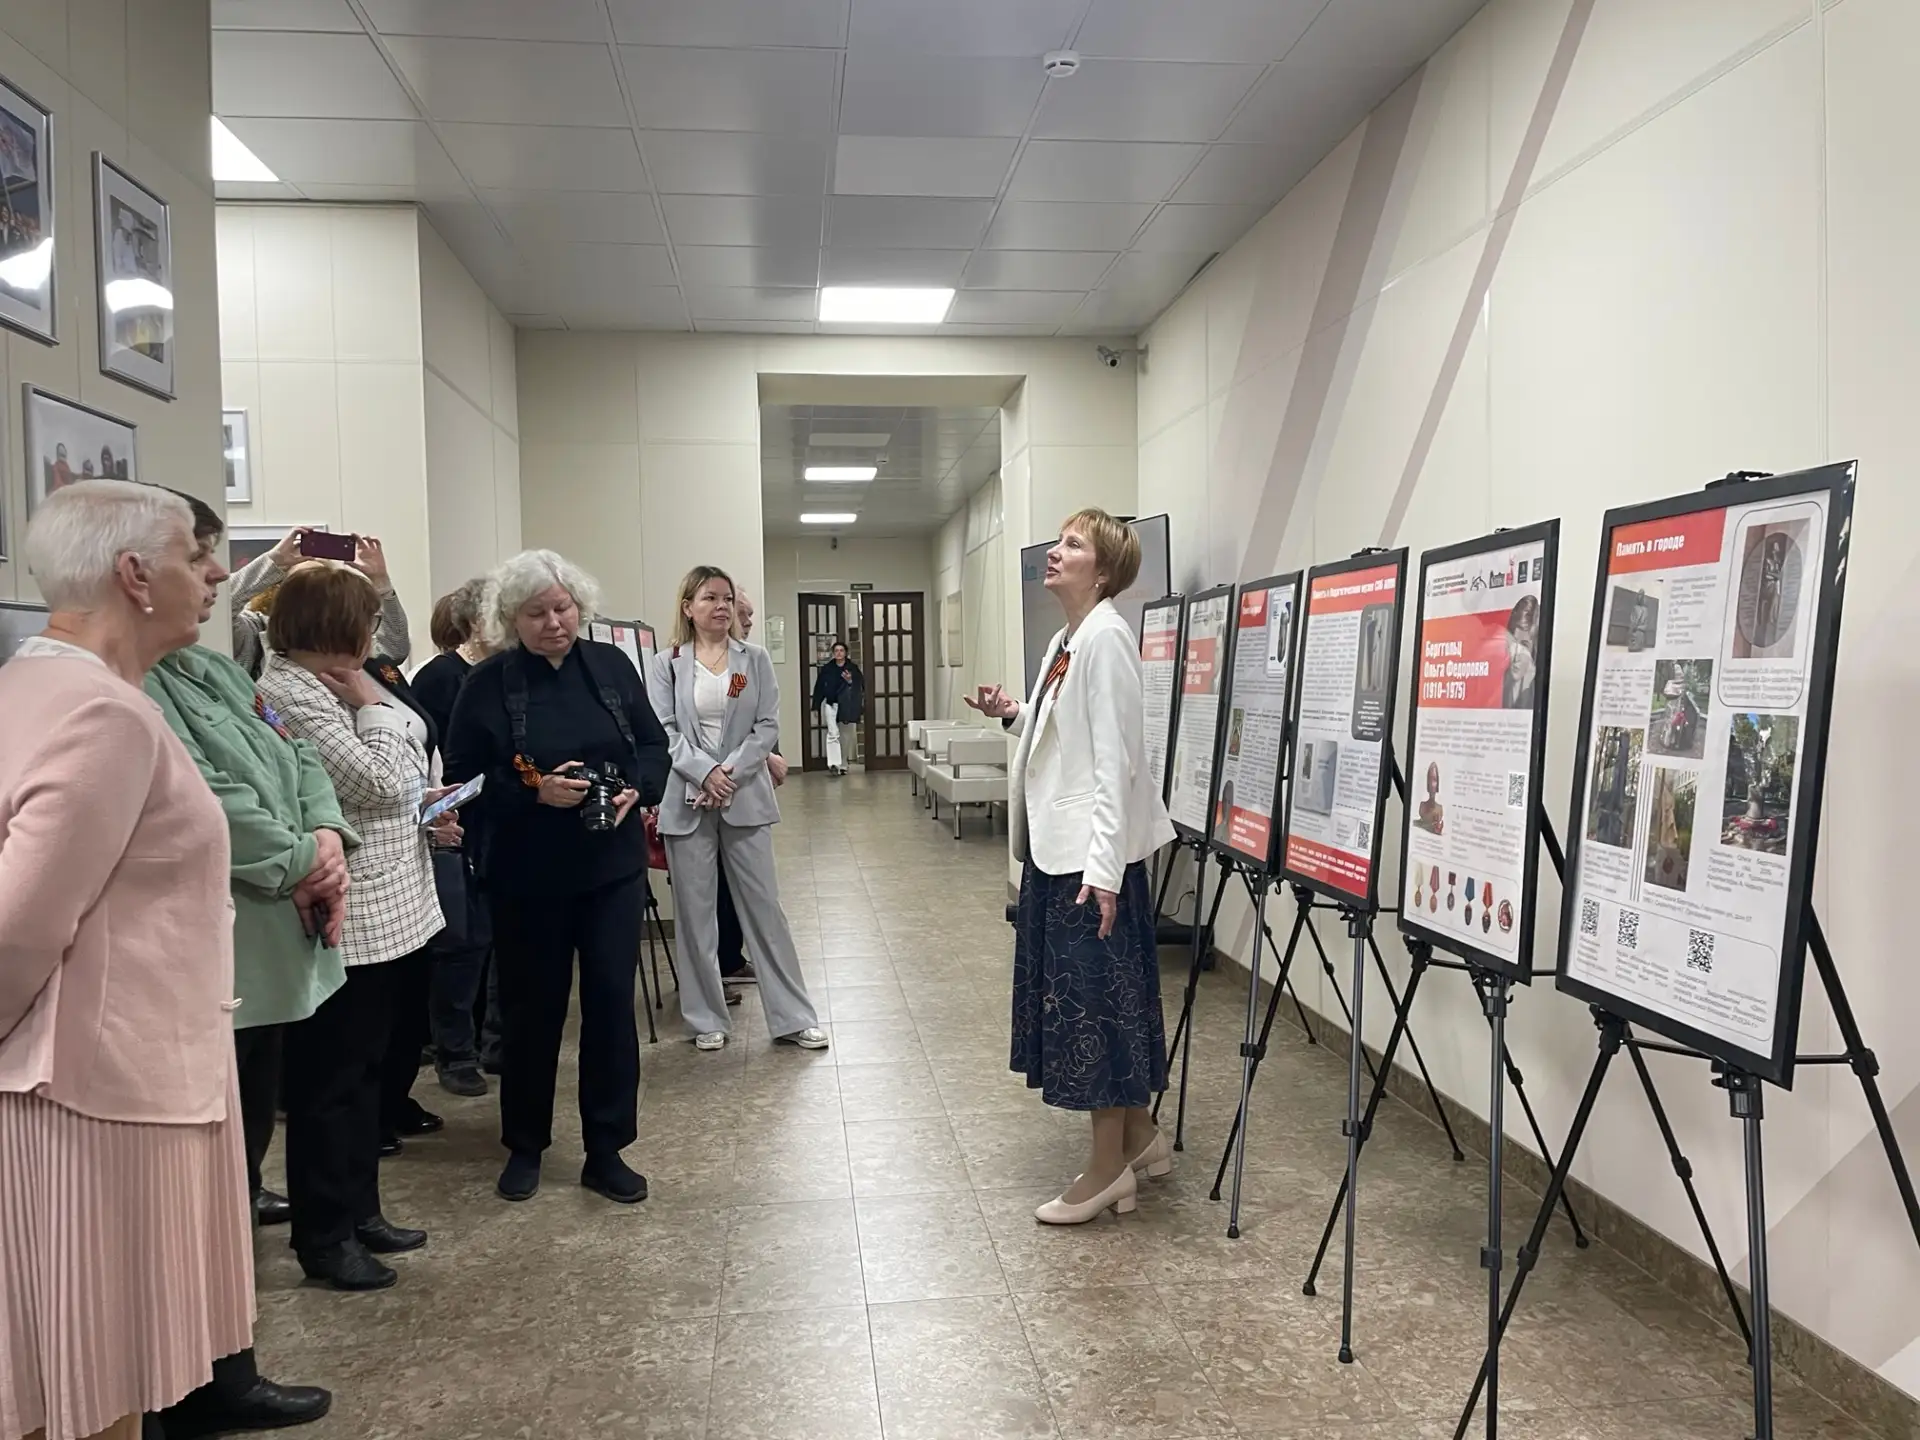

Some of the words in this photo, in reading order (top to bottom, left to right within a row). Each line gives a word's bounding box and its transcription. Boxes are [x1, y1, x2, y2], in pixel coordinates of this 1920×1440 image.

[1616, 542, 1645, 557] Память
[1646, 540, 1652, 553] в
[1653, 535, 1685, 552] городе
[1425, 641, 1462, 658] Берггольц
[1424, 661, 1445, 678] Ольга
[1446, 660, 1489, 679] Федоровна
